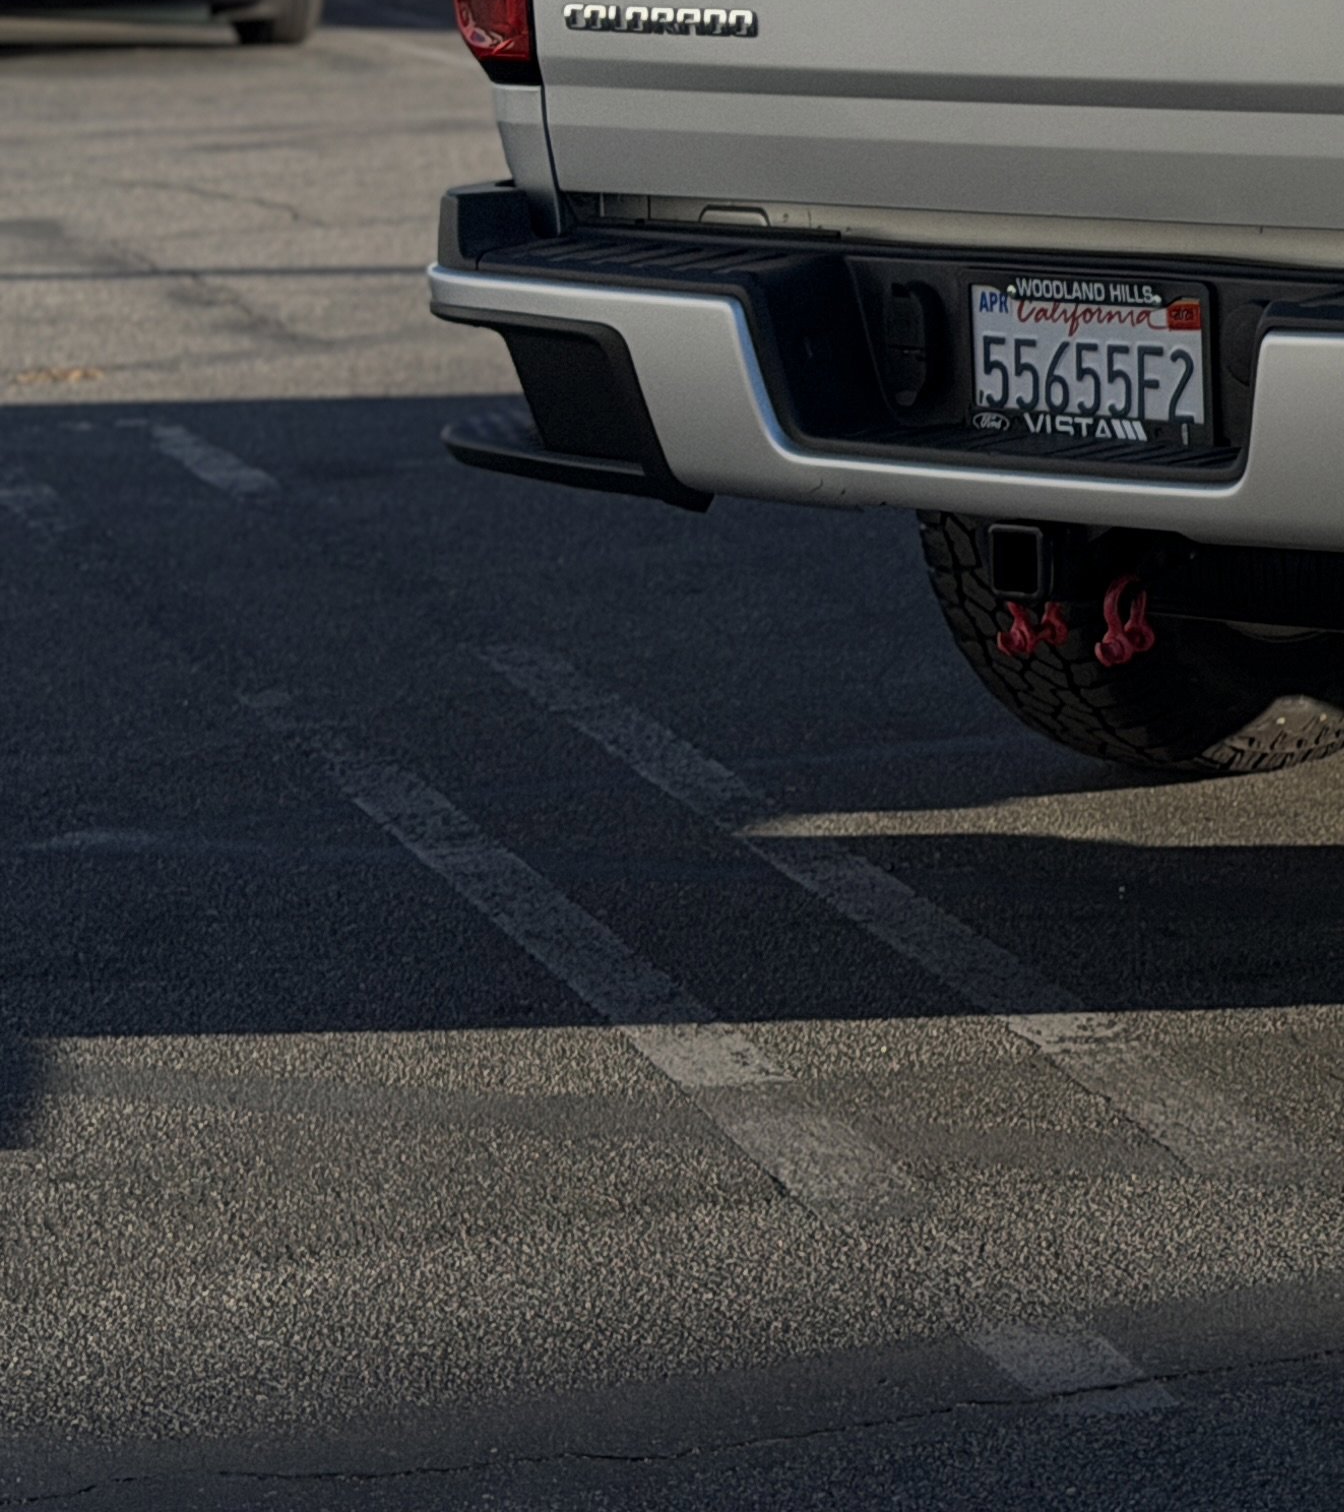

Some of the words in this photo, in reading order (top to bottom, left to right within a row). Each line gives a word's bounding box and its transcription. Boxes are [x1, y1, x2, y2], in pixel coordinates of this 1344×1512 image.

[563, 3, 758, 38] COLORADO
[979, 291, 1008, 314] APR
[1016, 278, 1104, 302] WOODLAND
[1110, 284, 1154, 304] HILLS
[1016, 300, 1166, 337] California
[981, 334, 1196, 425] 55655F2
[1023, 412, 1113, 438] VISTA
